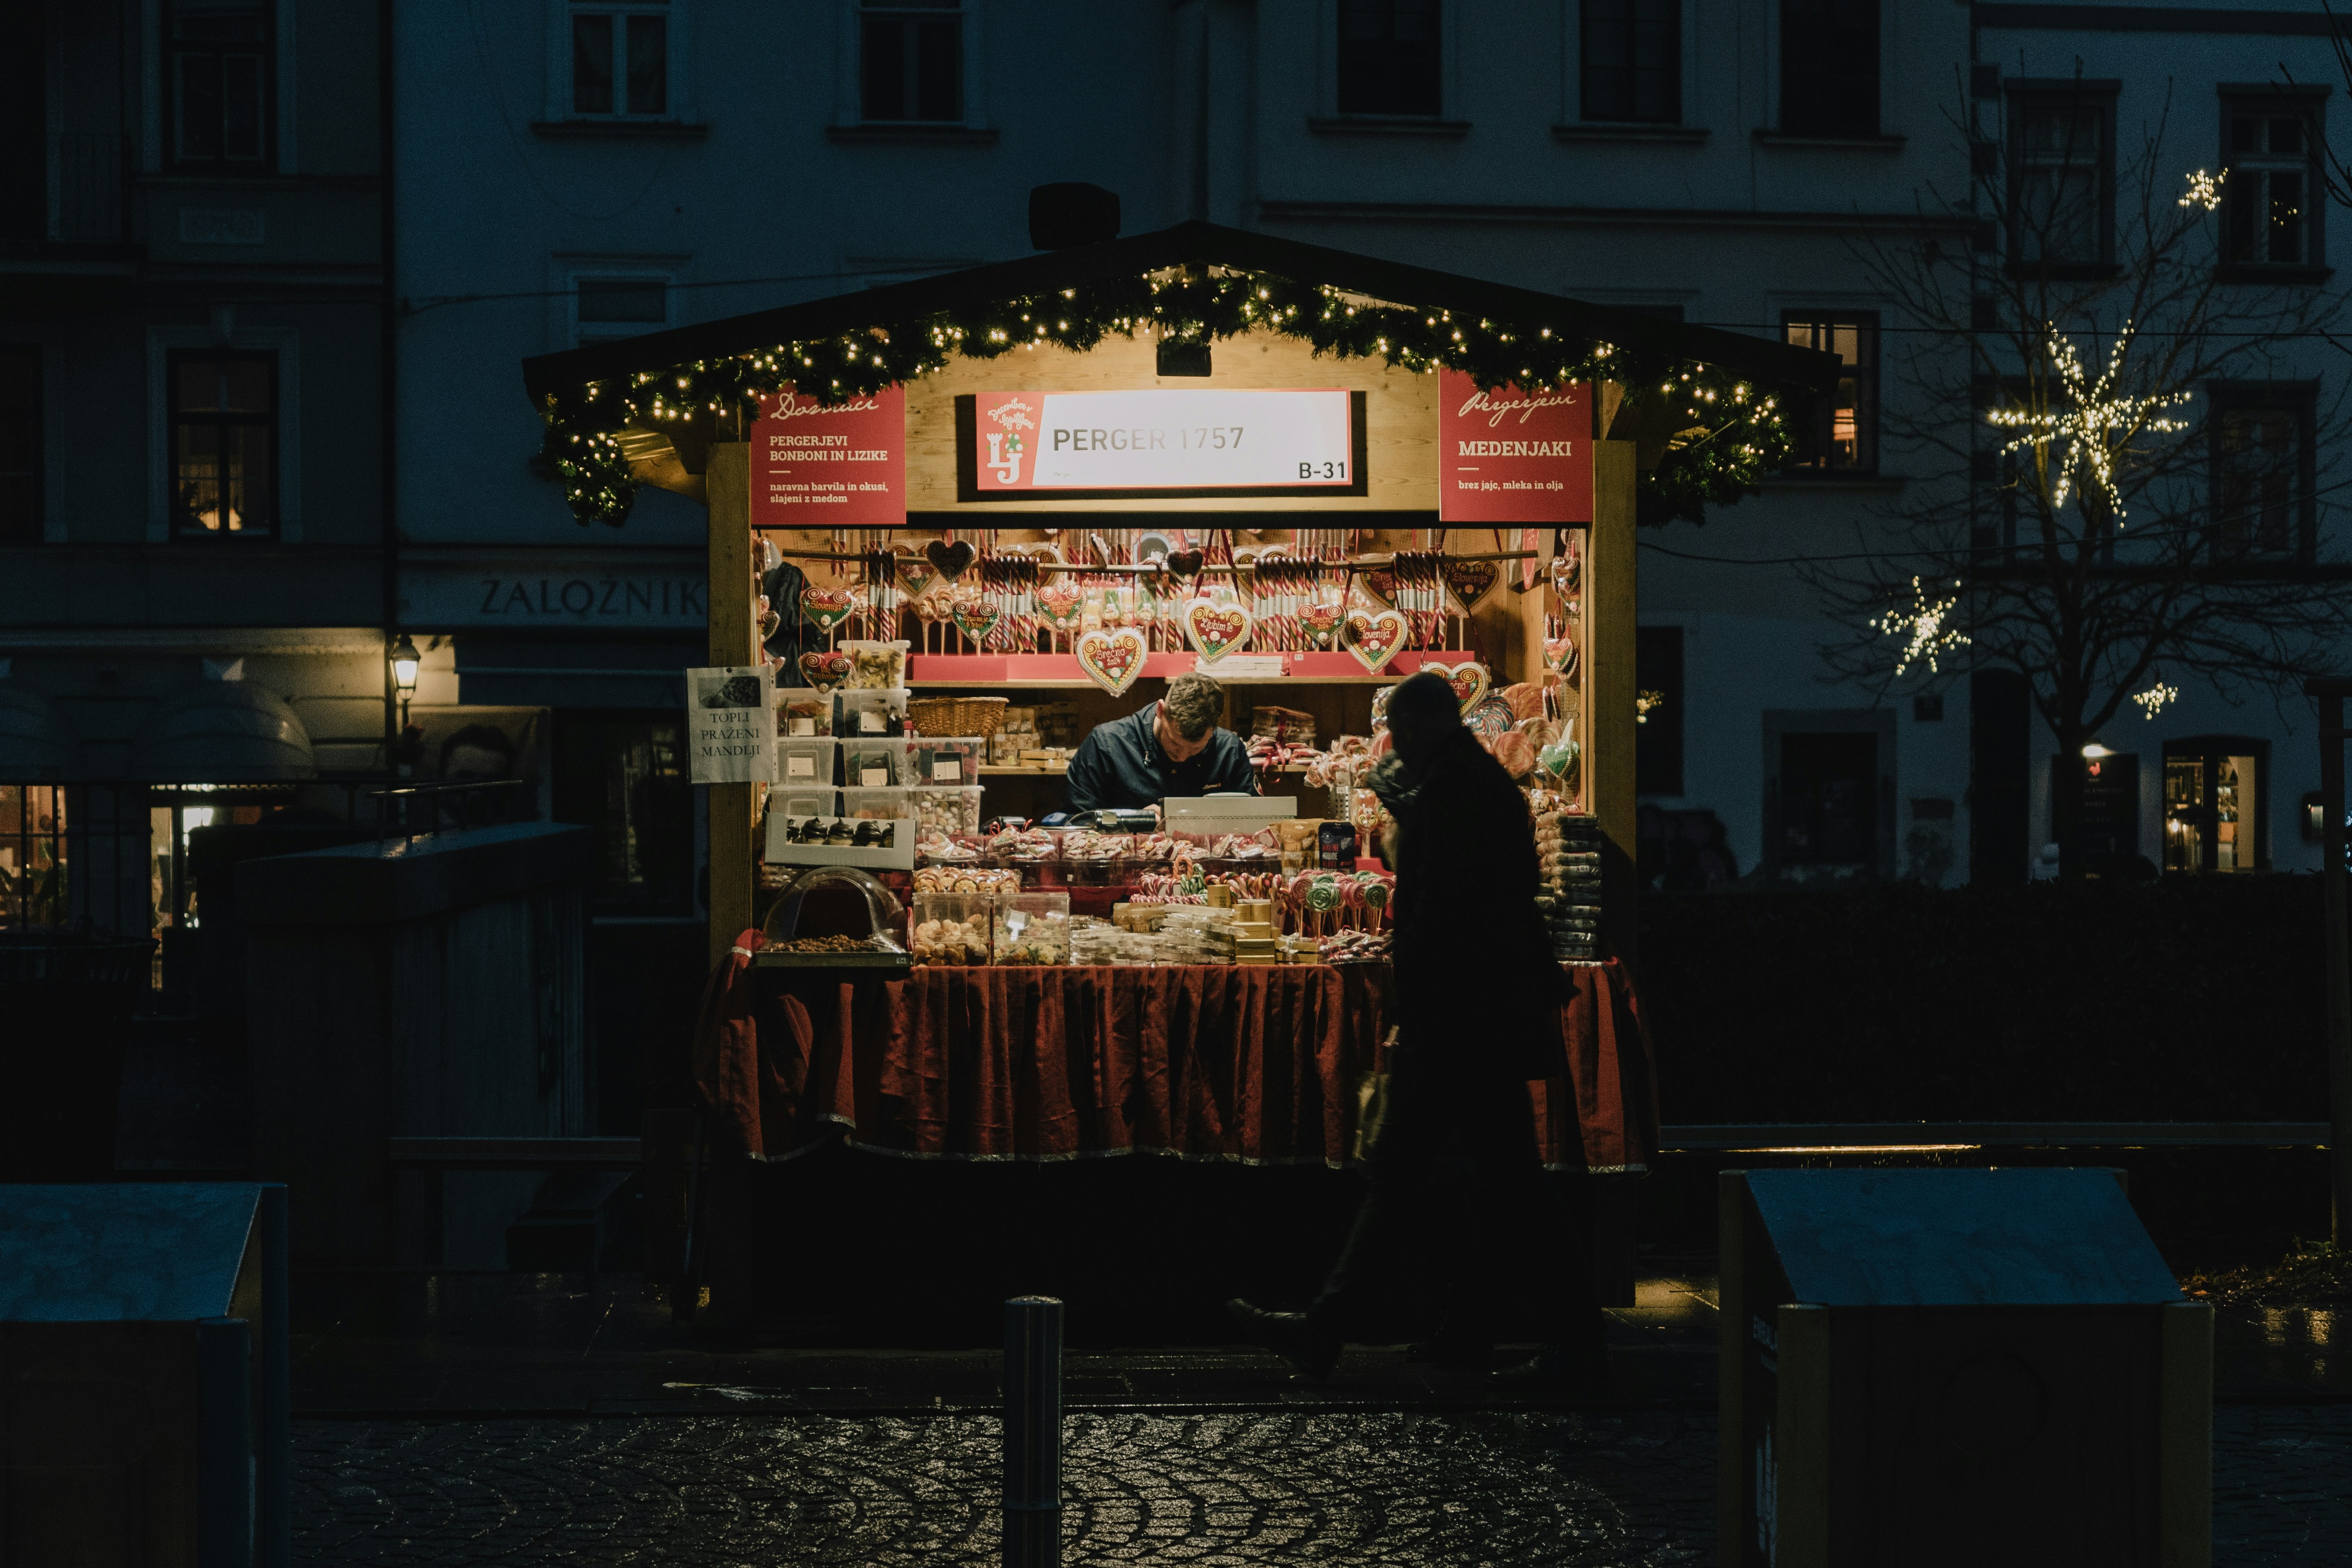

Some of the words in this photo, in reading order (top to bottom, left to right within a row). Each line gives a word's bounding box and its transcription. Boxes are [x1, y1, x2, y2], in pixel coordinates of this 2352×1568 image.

[987, 397, 1026, 421] December
[770, 435, 848, 446] PERGERJEVI
[1053, 428, 1166, 451] PERGER
[1179, 427, 1244, 450] 1757
[1458, 440, 1572, 457] MEDENJAKI
[770, 450, 828, 461] BONBONI
[830, 450, 844, 461] IN
[847, 450, 888, 461] LIZIKE
[1299, 461, 1345, 479] B-31
[811, 482, 845, 491] barvila
[847, 482, 857, 491] in
[859, 482, 888, 492] okusi,
[1458, 480, 1479, 489] brez
[1480, 480, 1500, 491] jajc,
[1503, 480, 1532, 489] mleka
[1534, 480, 1544, 489] in
[1546, 480, 1564, 491] olja
[770, 493, 803, 504] slajeni
[812, 493, 848, 503] medom
[810, 599, 842, 612] Slovenija
[1200, 617, 1226, 632] Ljubim
[1226, 621, 1233, 633] te
[1310, 615, 1333, 624] Srečno
[1357, 629, 1391, 641] Slovenija
[1095, 648, 1125, 660] Srečno
[1107, 656, 1121, 666] 2024
[709, 712, 750, 723] TOPLI
[701, 727, 761, 740] PRAŽENI
[701, 745, 761, 758] MANDLJI
